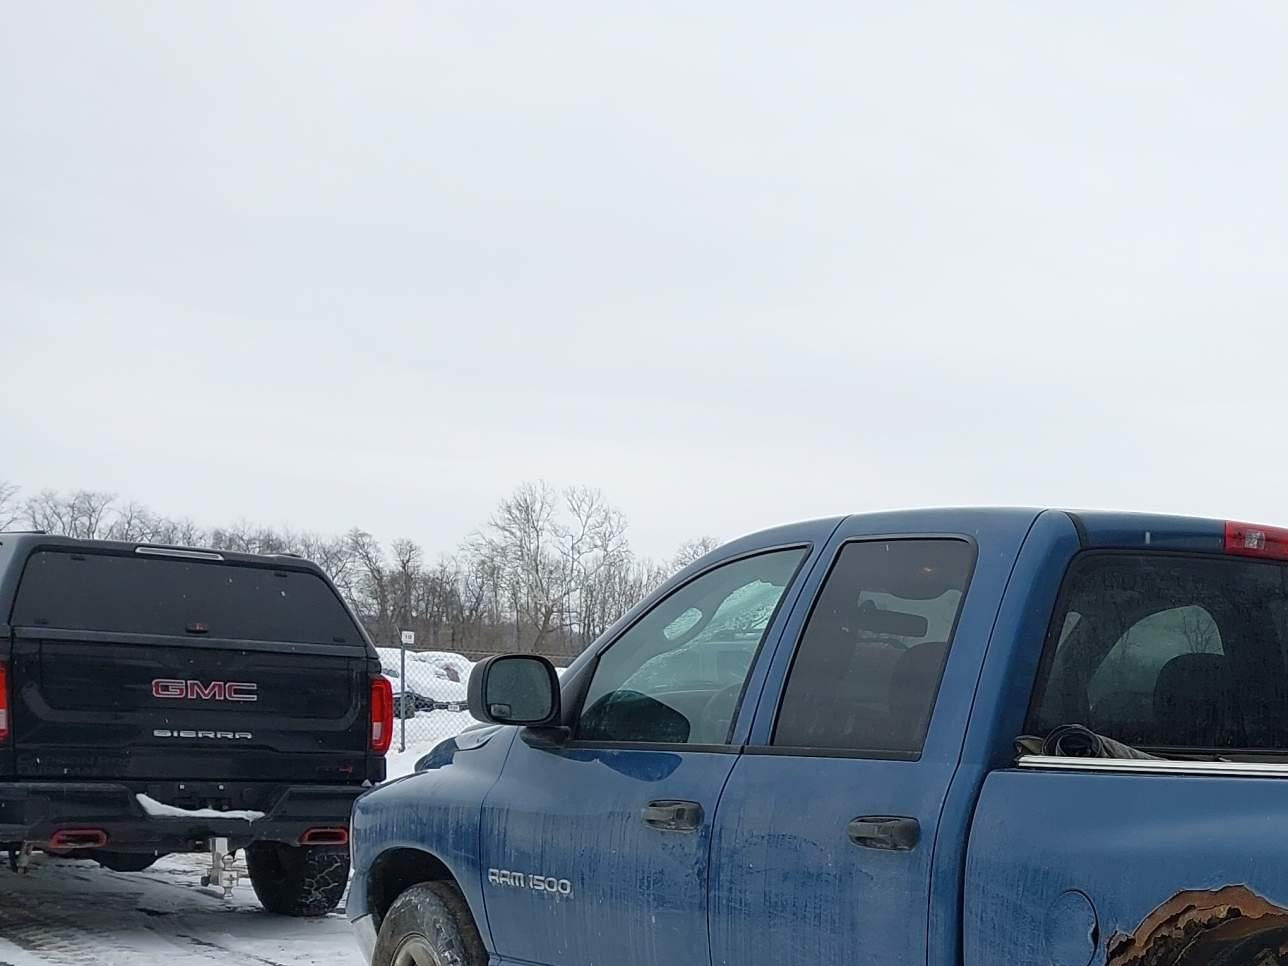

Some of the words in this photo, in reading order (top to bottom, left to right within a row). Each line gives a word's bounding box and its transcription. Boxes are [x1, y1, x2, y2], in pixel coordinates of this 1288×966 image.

[152, 679, 257, 701] GMC
[153, 730, 252, 739] SIERRA
[488, 868, 524, 888] RAM
[528, 874, 571, 894] 1500
